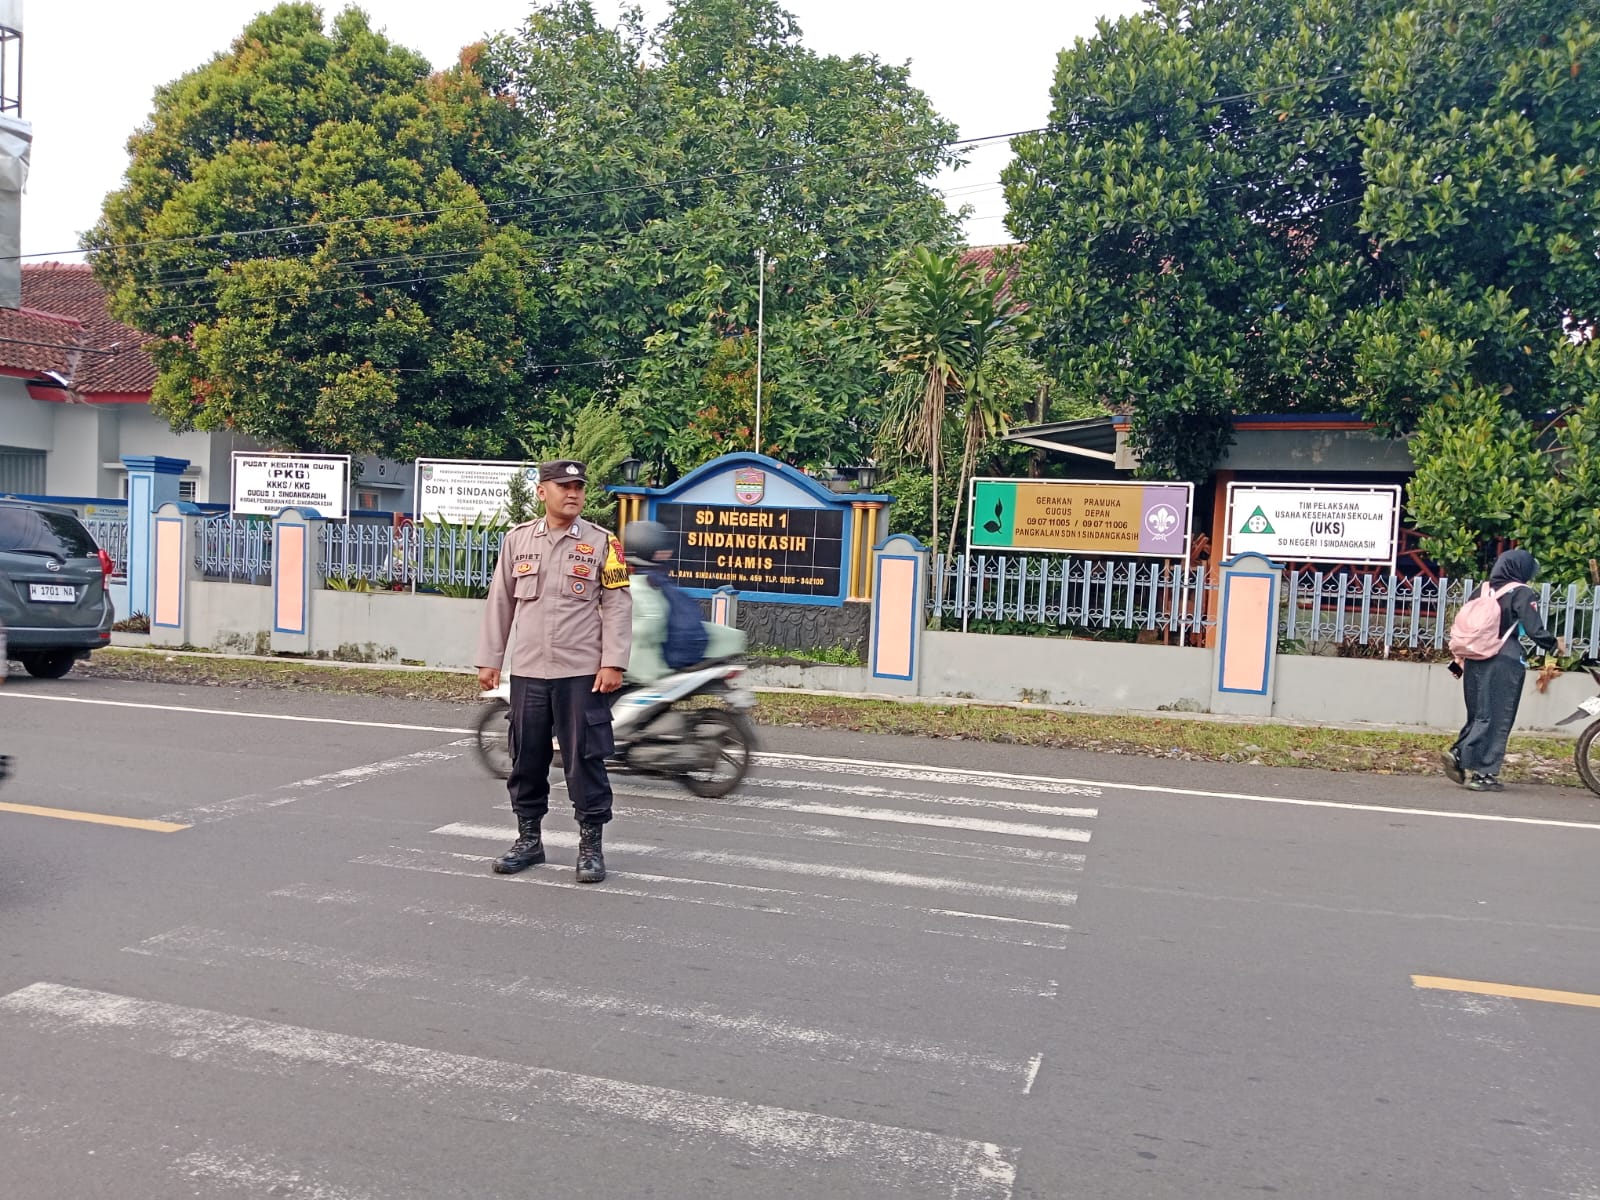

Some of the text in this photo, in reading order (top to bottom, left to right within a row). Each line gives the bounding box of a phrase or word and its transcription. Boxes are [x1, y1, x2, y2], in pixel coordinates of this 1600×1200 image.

[266, 480, 288, 489] KKKS
[294, 482, 310, 490] KKG
[425, 485, 446, 494] SDN
[449, 486, 453, 494] 1
[1036, 496, 1121, 508] GERAKAN PRAMUKA
[1299, 502, 1360, 510] TIM PELAKSANA
[1046, 508, 1110, 518] GUGUS DEPAN
[1302, 512, 1346, 520] KESEHATAN
[1347, 512, 1384, 521] SEKOLAH
[696, 510, 788, 528] SD NEGERI 1
[1016, 528, 1060, 537] PANGKALAN
[1061, 530, 1076, 538] SDN
[1082, 530, 1139, 540] SINDANGKASIH
[1310, 522, 1345, 538] (UKS)
[688, 532, 806, 552] SINDANGKASIH
[1290, 538, 1317, 546] NEGERI
[1324, 540, 1376, 548] SINDANGKASIH
[568, 554, 597, 564] POLRI
[717, 555, 773, 570] CIAMIS
[41, 586, 60, 596] 1701
[64, 588, 74, 596] NA
